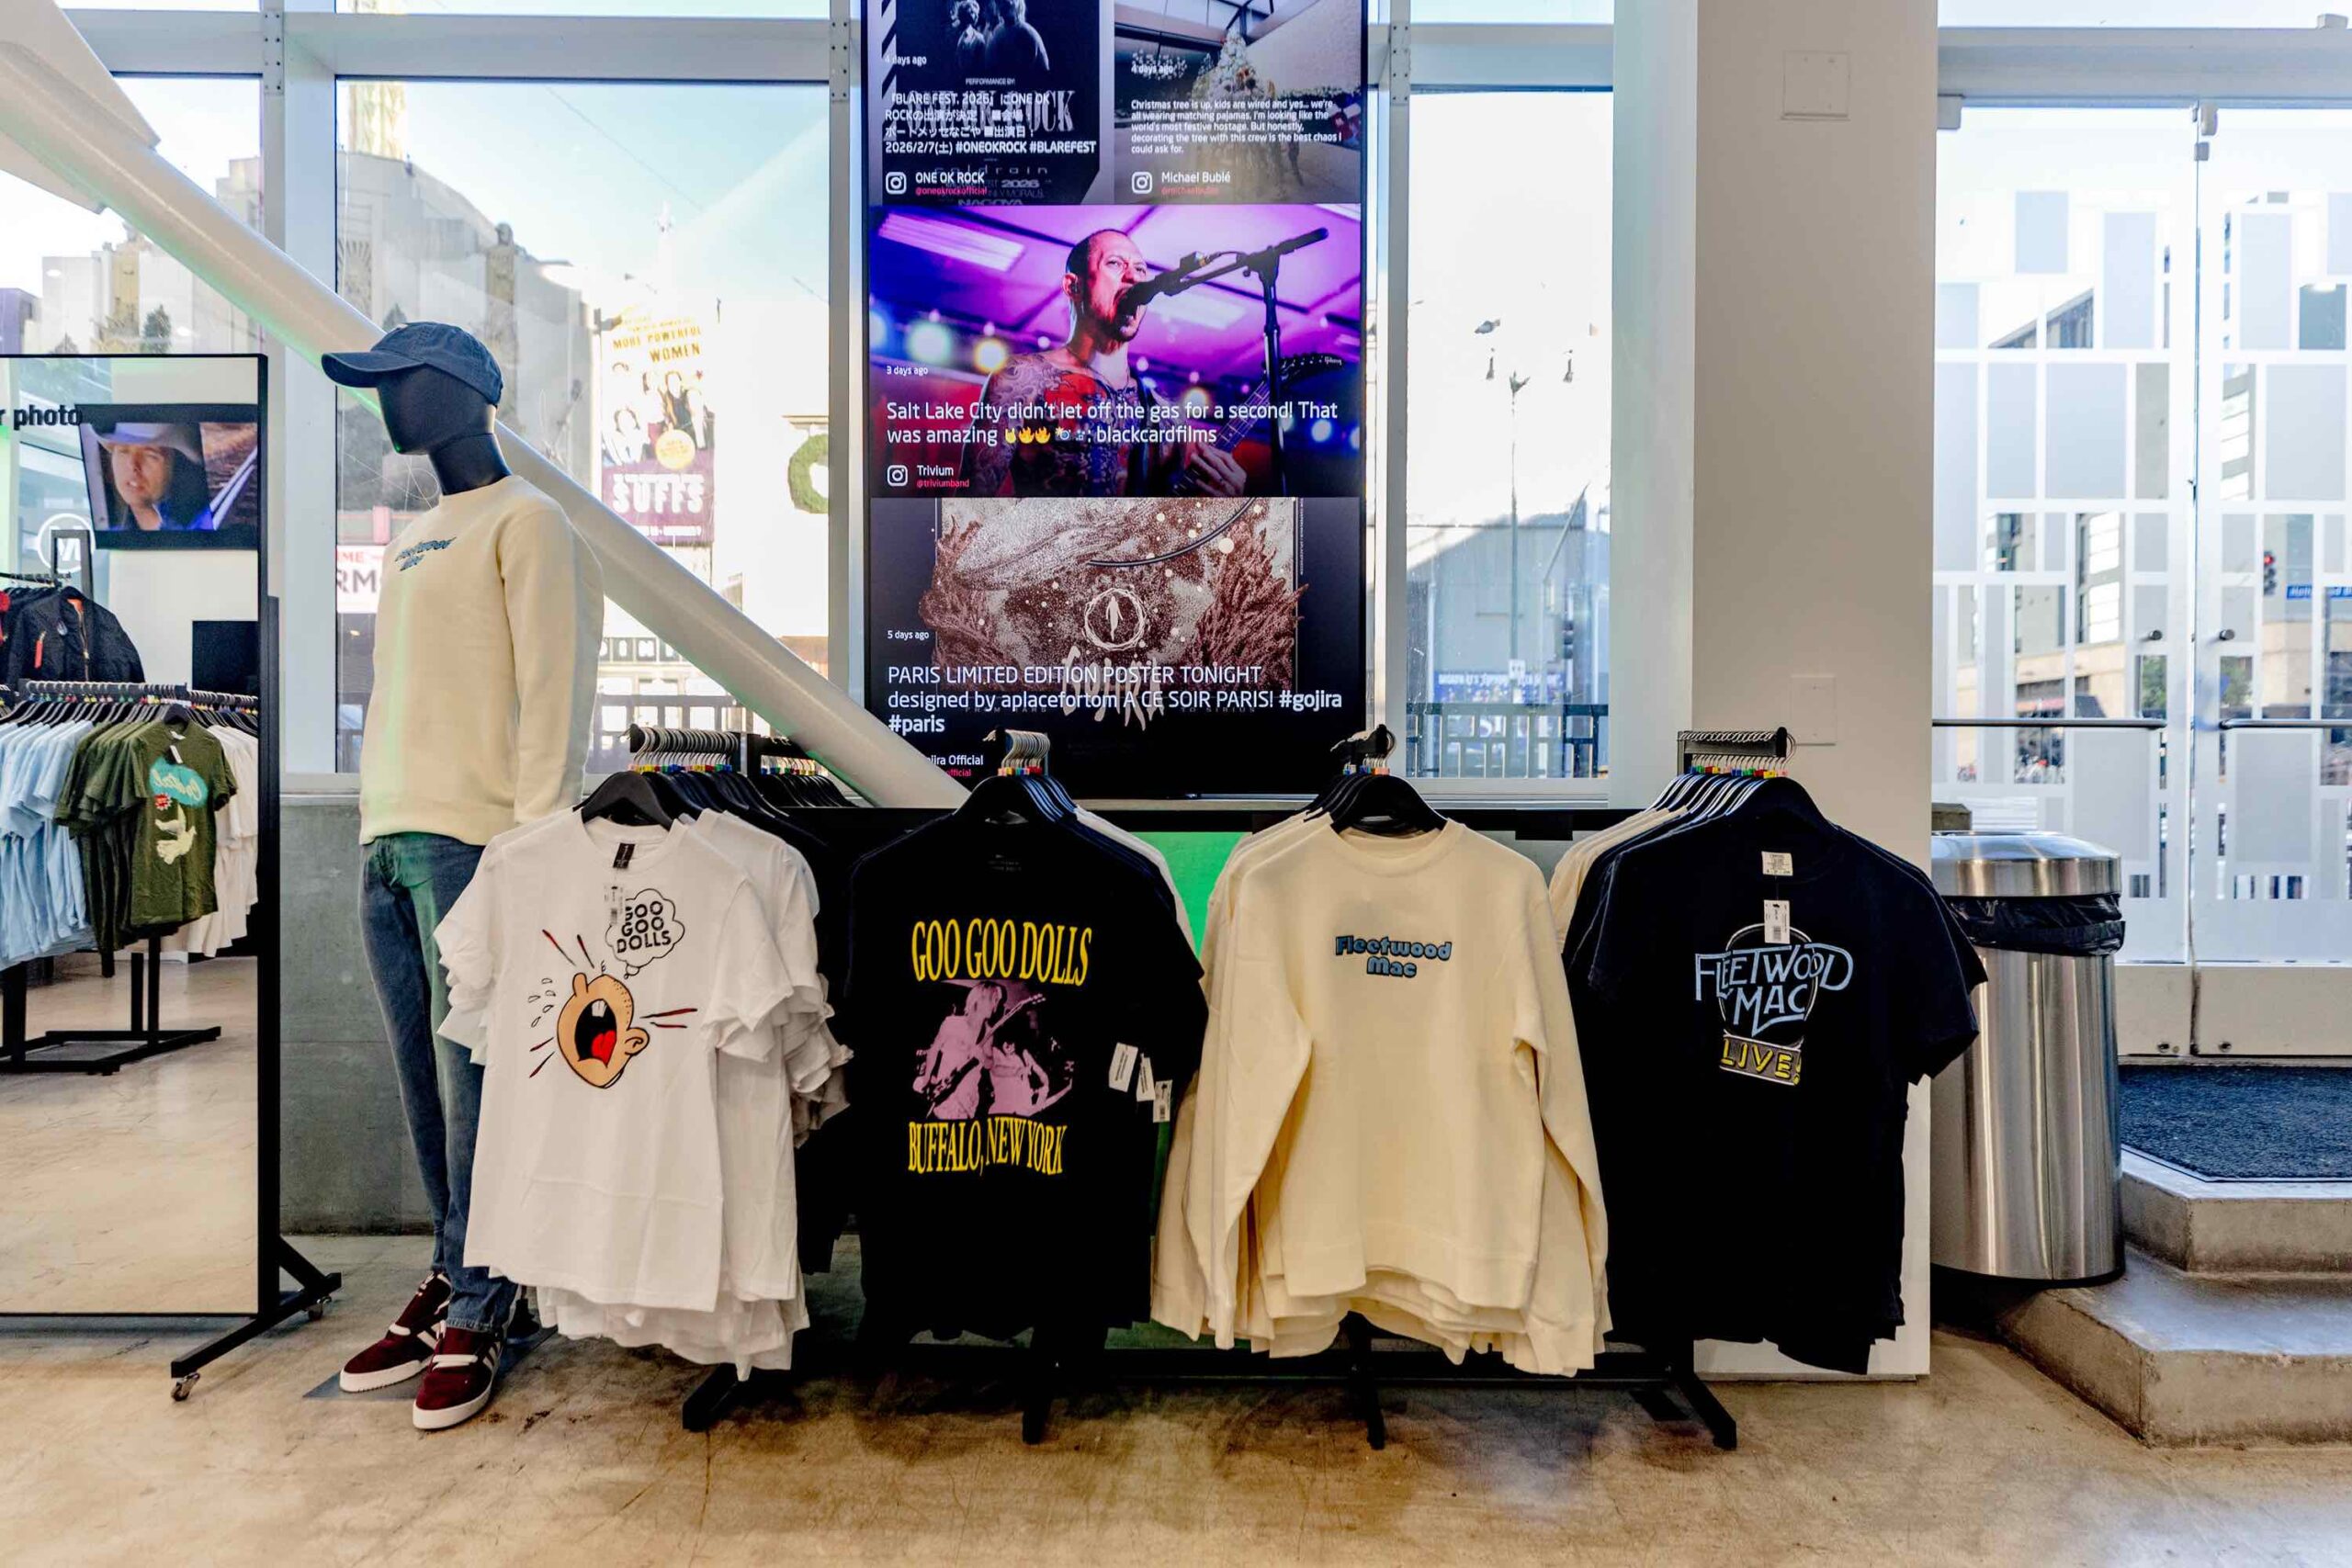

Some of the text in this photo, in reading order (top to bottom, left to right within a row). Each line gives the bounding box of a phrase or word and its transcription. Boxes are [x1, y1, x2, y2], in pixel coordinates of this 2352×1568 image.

[892, 56, 910, 66] days
[911, 57, 927, 66] ago
[1131, 65, 1173, 75] 4 days ago
[1131, 100, 1171, 109] Christmas
[1173, 100, 1189, 109] tree
[1214, 99, 1231, 109] kids
[1248, 99, 1271, 109] wired
[1272, 99, 1287, 109] and
[1131, 111, 1141, 120] all
[1143, 111, 1176, 123] wearing
[1177, 111, 1215, 123] matching
[1216, 111, 1251, 123] pajamas.
[1268, 111, 1297, 123] looking
[1298, 111, 1313, 120] like
[1315, 111, 1329, 120] the
[1131, 122, 1305, 134] world's most festive hostage. But honestly,
[1131, 133, 1174, 145] decorating
[1176, 133, 1190, 142] the
[1192, 133, 1208, 142] tree
[1210, 133, 1229, 142] with
[1230, 133, 1246, 142] this
[1269, 133, 1276, 142] is
[1278, 133, 1292, 142] the
[1294, 133, 1312, 142] best
[1313, 133, 1337, 142] chaos
[956, 141, 1027, 154] #ONEOKROCK
[1029, 141, 1097, 154] #BLAREFEST
[1131, 144, 1184, 153] could ask for.
[915, 172, 985, 184] ONE OK ROCK
[1161, 171, 1230, 184] Michael Bublé
[887, 366, 929, 377] 3 days ago
[14, 404, 83, 431] photo
[888, 401, 1338, 423] Salt Lake City didn't let off the gas for a second! That
[888, 429, 920, 444] was
[926, 427, 998, 446] amazing
[1096, 425, 1217, 444] blackcardfilms
[917, 465, 954, 477] Trivium
[917, 479, 969, 488] @triviumband
[888, 630, 929, 641] 5 days ago
[888, 666, 1262, 683] PARIS LIMITED EDITION POSTER TONIGHT
[888, 690, 1342, 712] designed by aplacefortom A CE SOIR PARIS! #gojira
[888, 715, 944, 736] #paris
[948, 754, 984, 765] Official
[622, 917, 664, 937] GOO
[616, 931, 672, 953] DOLLS
[1336, 935, 1453, 961] Fleetwood
[912, 919, 1091, 987] GOO GOO DOLLS
[1366, 955, 1418, 978] Mac
[1695, 942, 1854, 1001] FLEETWOOD
[1732, 984, 1808, 1038] MAC
[1720, 1038, 1803, 1086] LIVE!
[908, 1116, 1068, 1177] BUFFALO, NEW YORK
